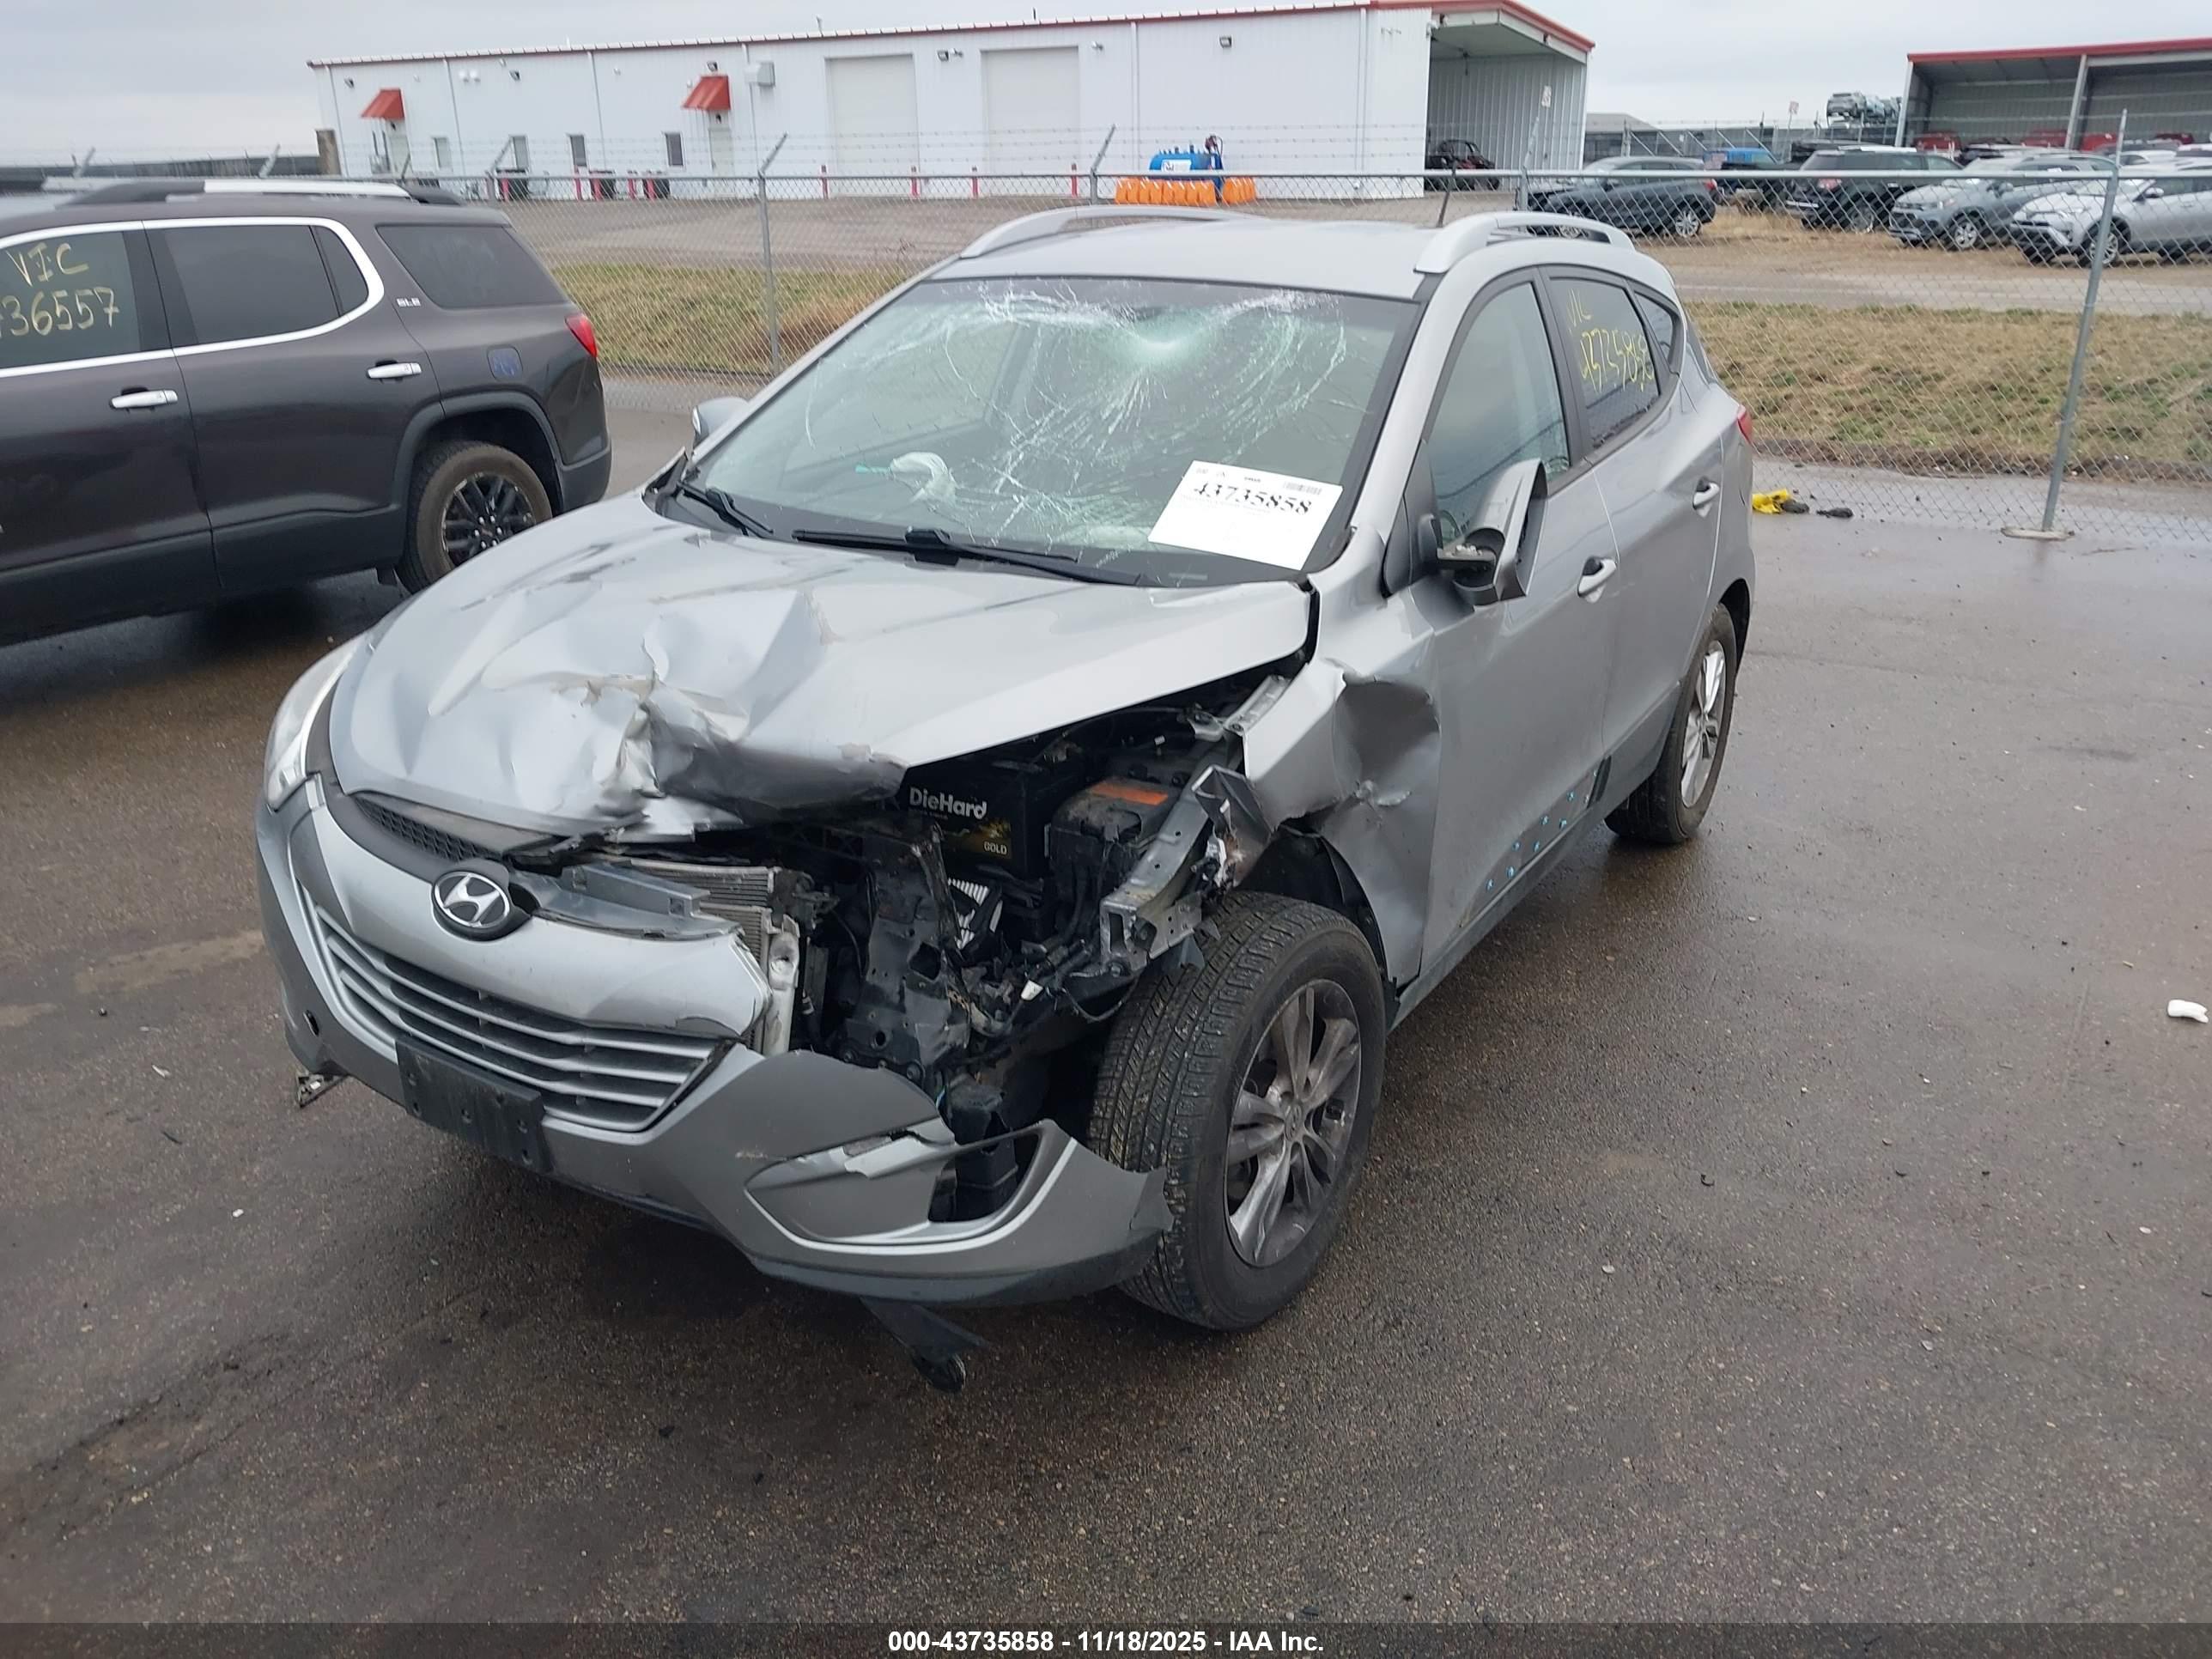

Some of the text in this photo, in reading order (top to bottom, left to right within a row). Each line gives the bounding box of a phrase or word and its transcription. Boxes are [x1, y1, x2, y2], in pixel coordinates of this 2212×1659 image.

[5, 242, 89, 287] VIC
[0, 286, 120, 336] 36557
[1193, 481, 1313, 516] 43735858
[909, 787, 988, 819] DieHard
[983, 841, 1007, 855] GOLD
